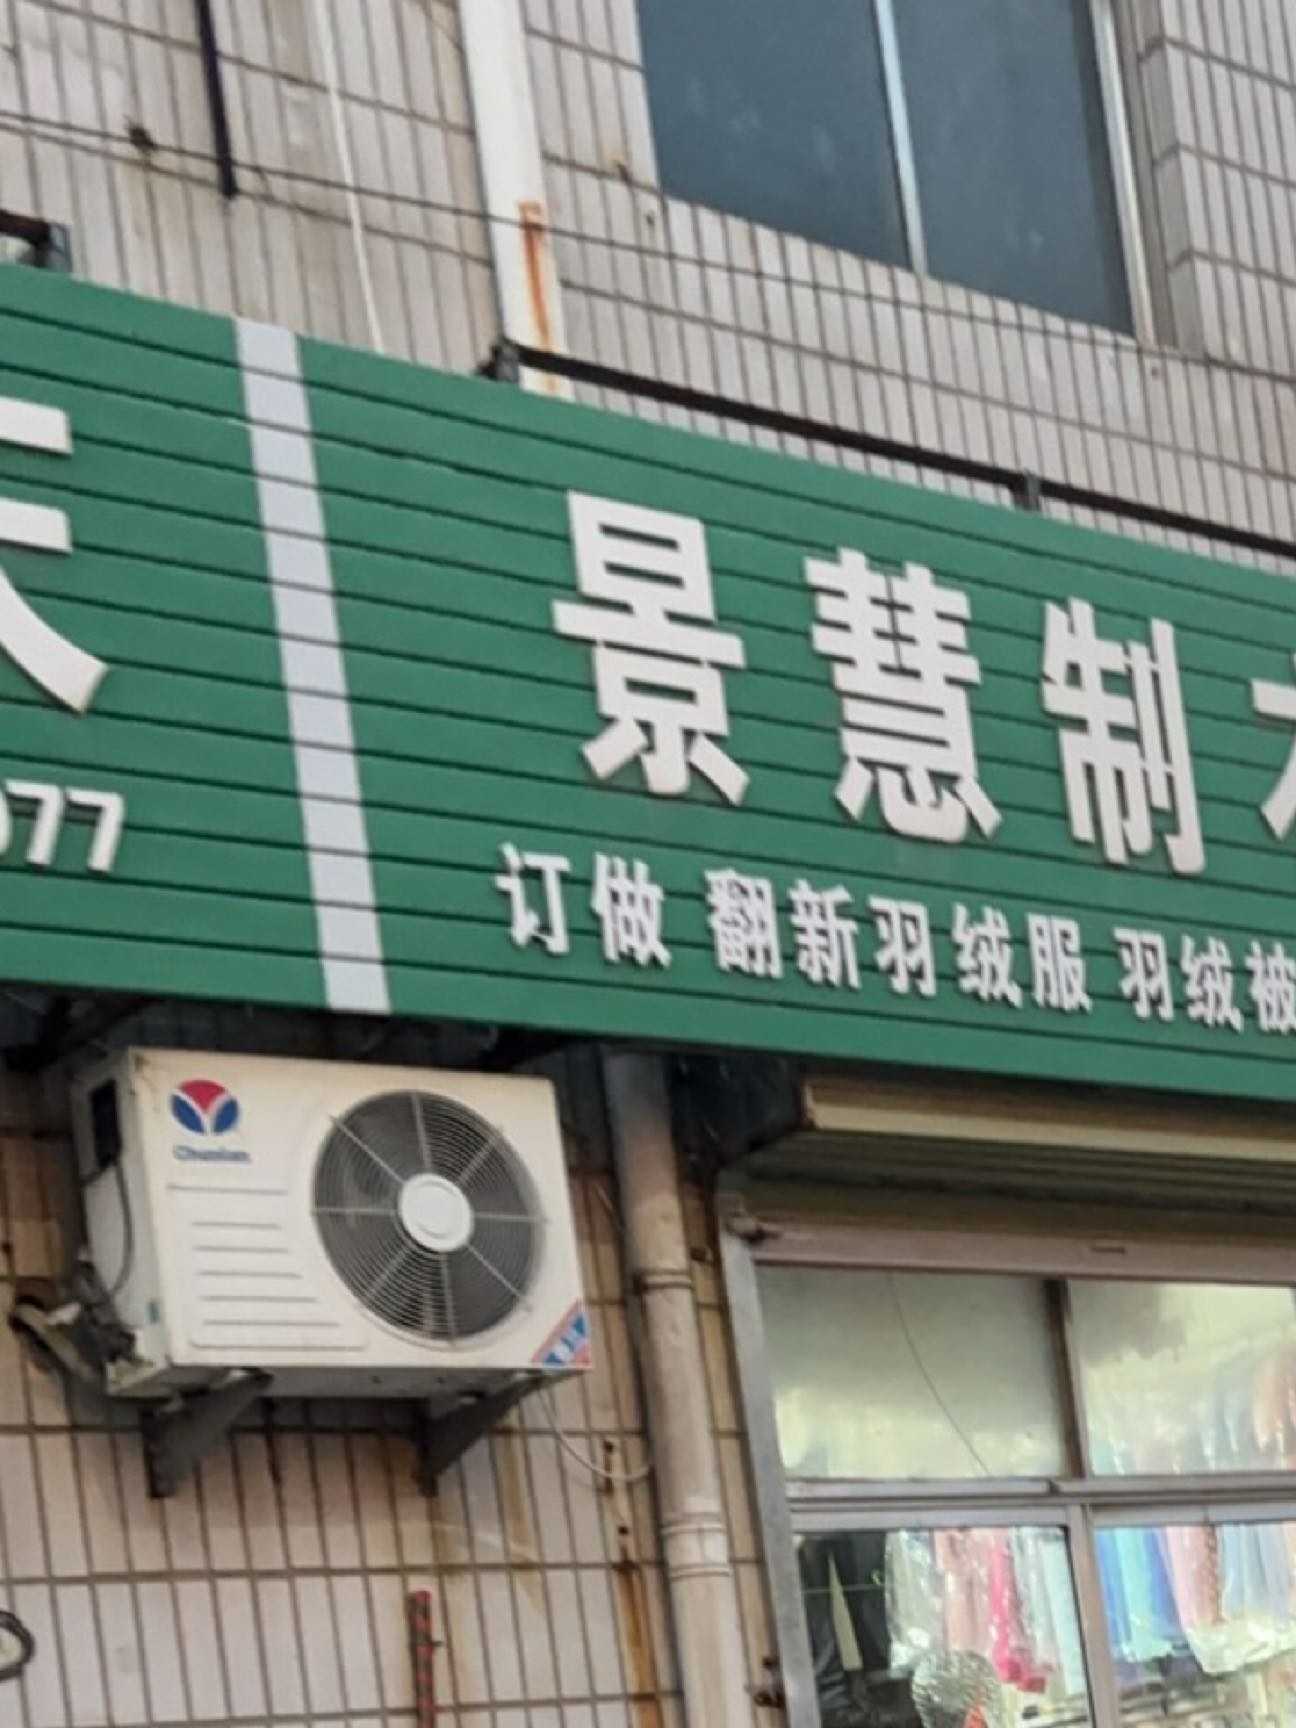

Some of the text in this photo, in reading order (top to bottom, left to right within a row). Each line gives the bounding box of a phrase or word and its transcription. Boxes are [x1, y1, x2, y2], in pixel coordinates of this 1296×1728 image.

[0, 778, 124, 873] 77
[494, 841, 671, 968] 订做
[705, 867, 1091, 1013] 翻新羽绒服
